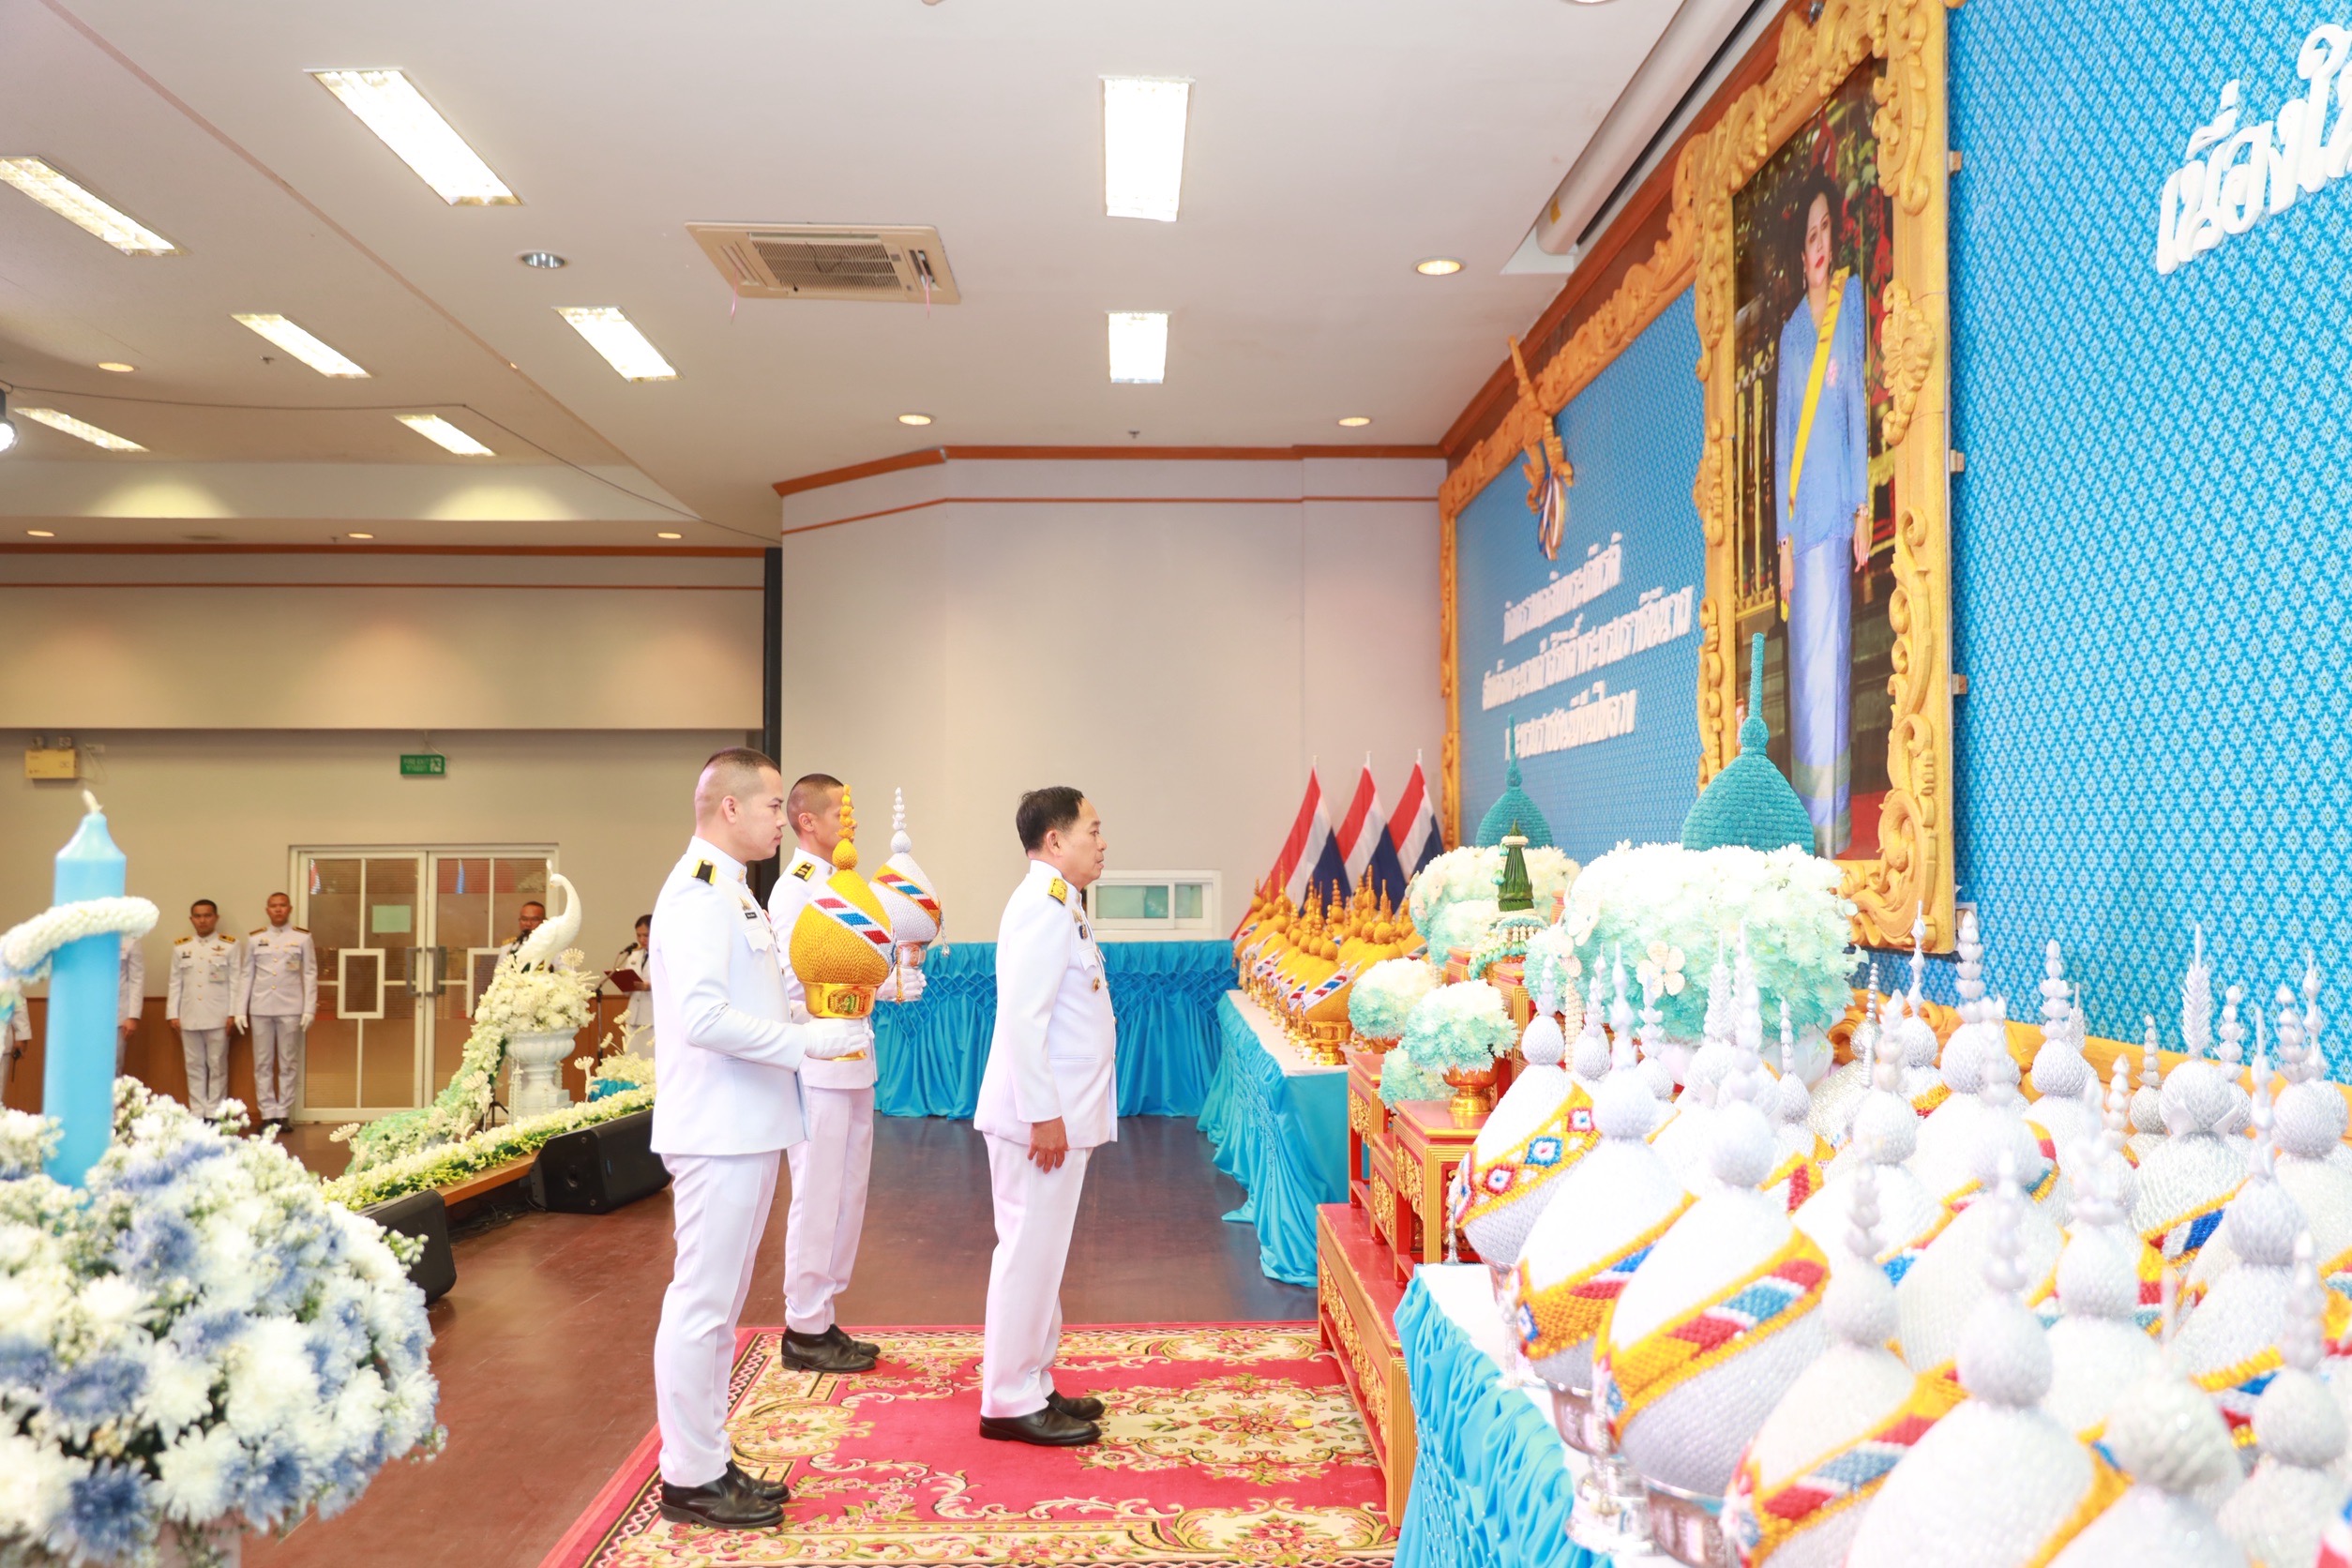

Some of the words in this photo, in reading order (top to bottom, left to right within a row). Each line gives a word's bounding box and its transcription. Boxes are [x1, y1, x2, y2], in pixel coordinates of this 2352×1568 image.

[1505, 681, 1636, 761] พะบรมราชชนนีพันปีหลวง
